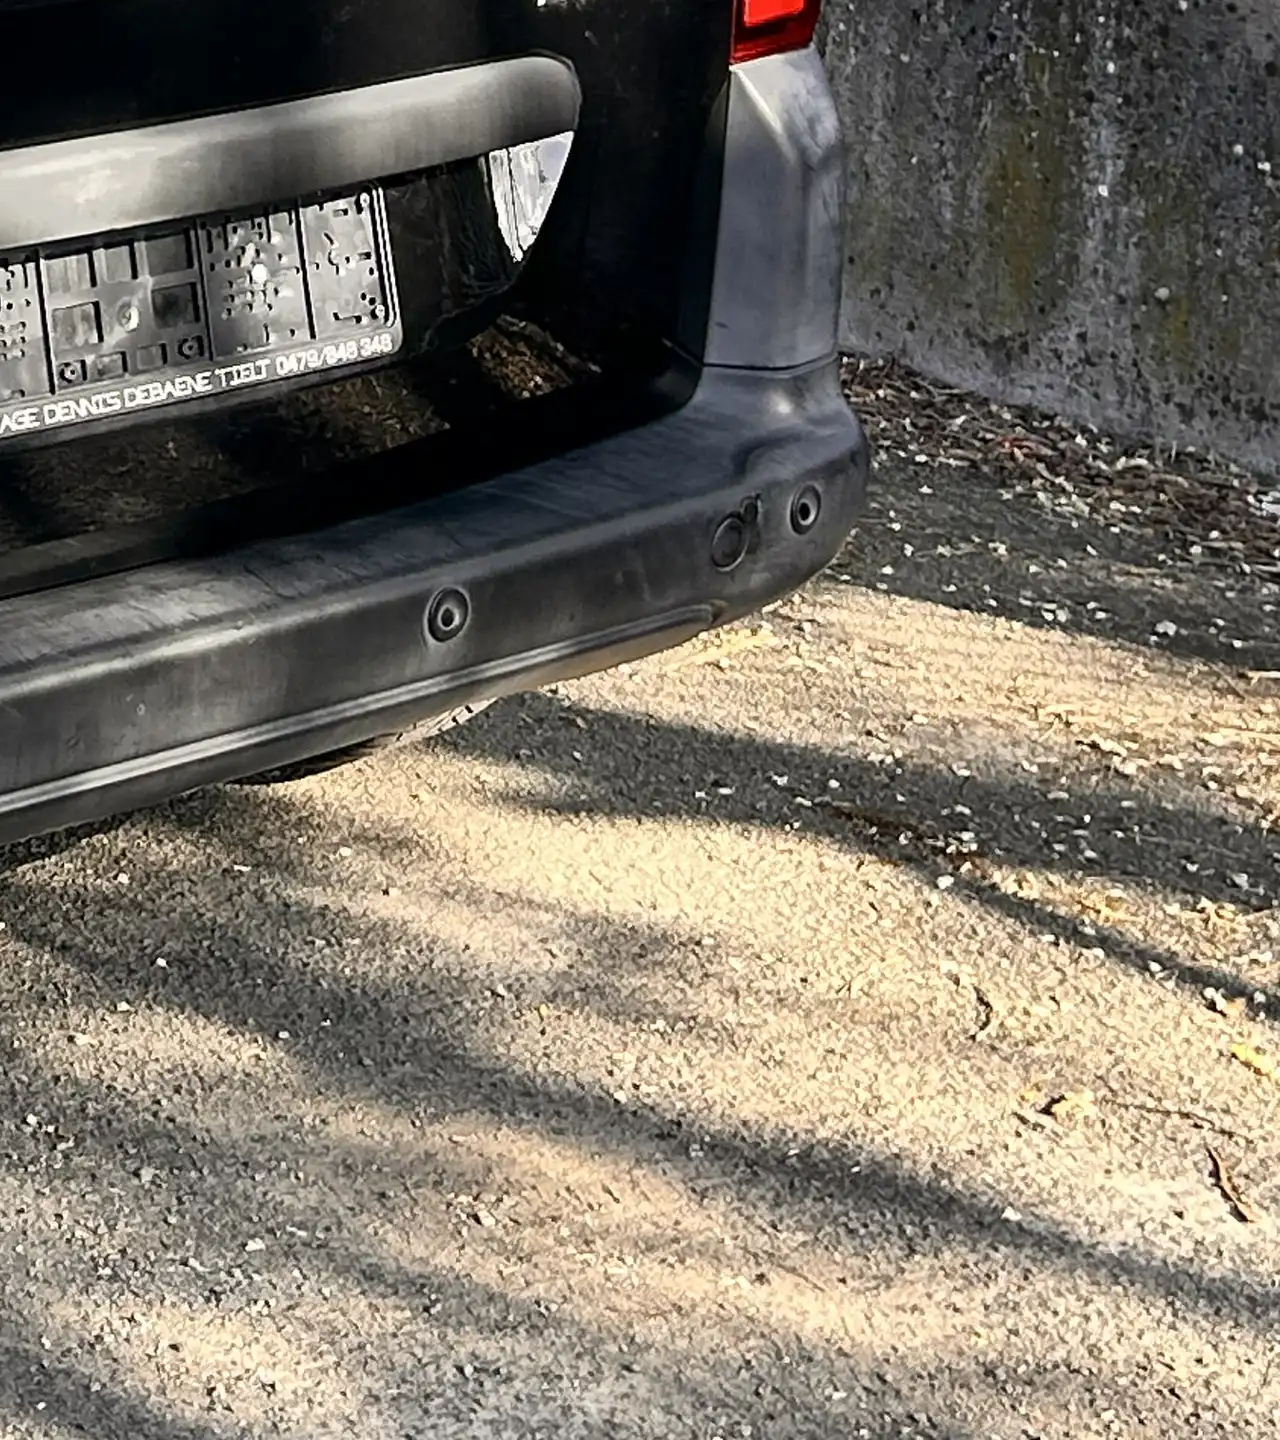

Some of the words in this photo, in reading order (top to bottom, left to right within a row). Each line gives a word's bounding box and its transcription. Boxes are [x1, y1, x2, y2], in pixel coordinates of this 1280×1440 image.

[43, 390, 122, 425] DENNIS
[124, 371, 213, 407] DEBAENE
[214, 357, 272, 387] TIELT
